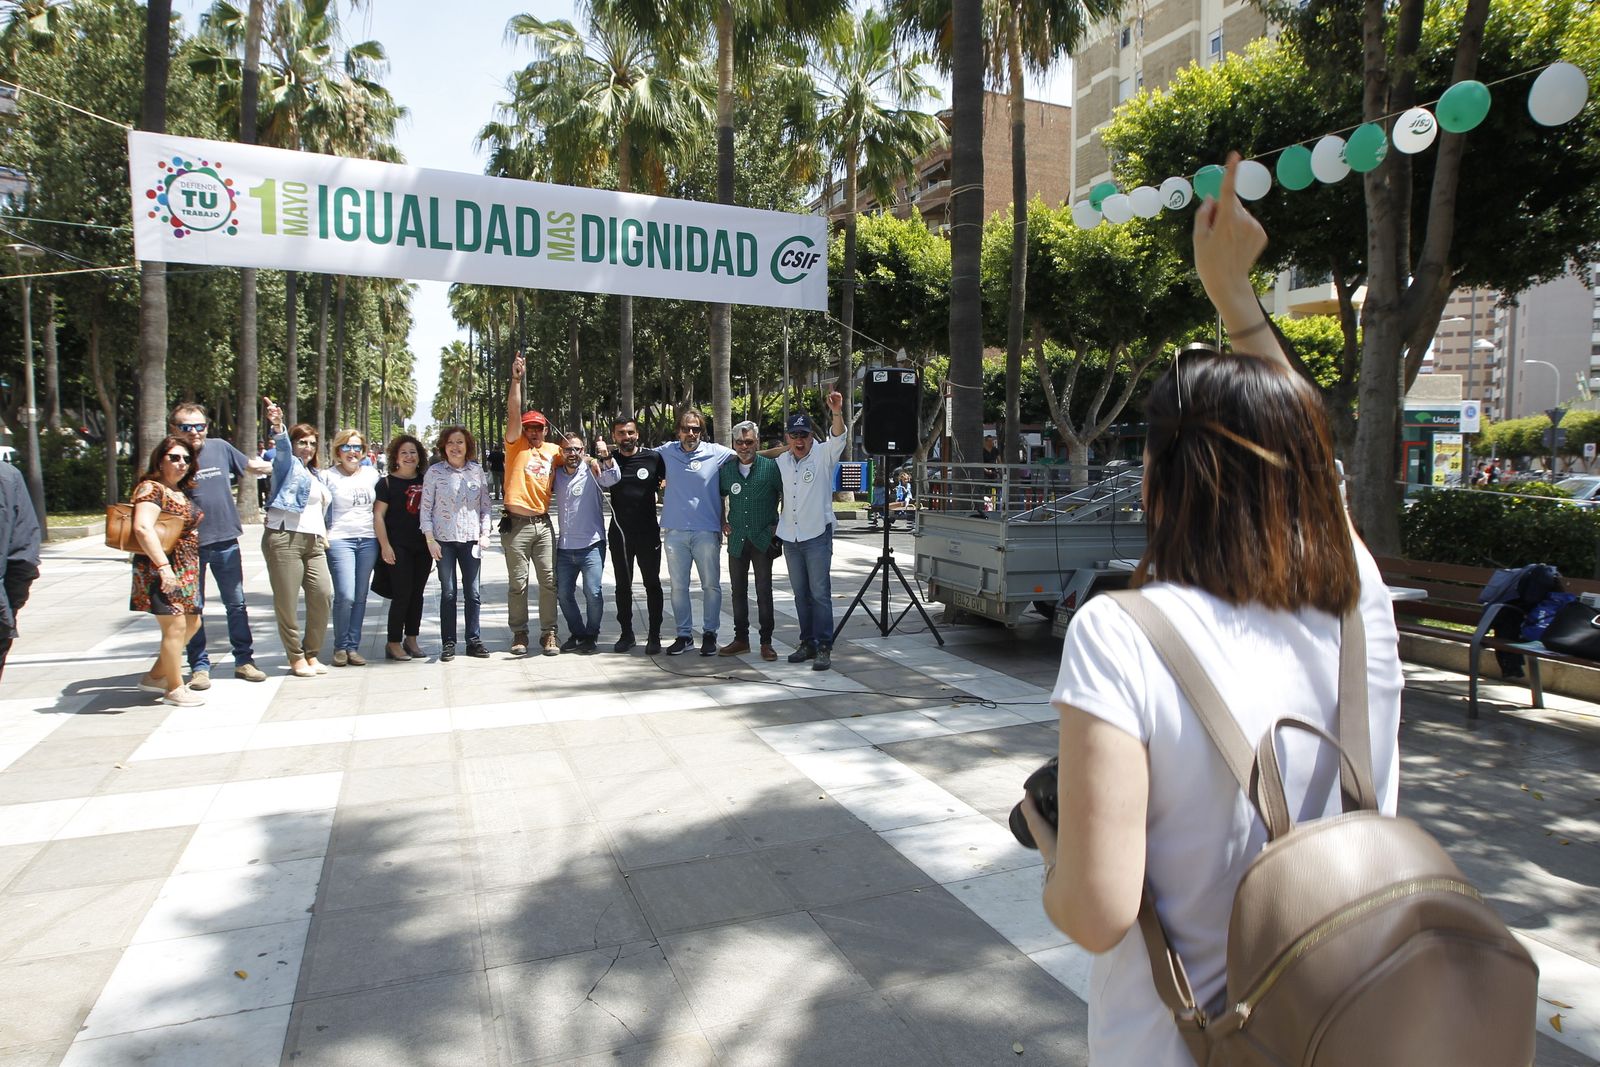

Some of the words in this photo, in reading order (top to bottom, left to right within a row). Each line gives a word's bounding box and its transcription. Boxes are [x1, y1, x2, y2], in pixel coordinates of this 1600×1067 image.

[1409, 118, 1430, 128] CSIF
[180, 181, 217, 192] DEFIENDE
[181, 190, 218, 209] TU
[182, 209, 220, 218] TRABAJO
[249, 178, 277, 235] 1
[282, 181, 309, 236] MAYO
[318, 184, 541, 258] IGUALDAD
[547, 210, 576, 262] MAS
[581, 213, 758, 277] DIGNIDAD
[780, 249, 821, 270] CSIF
